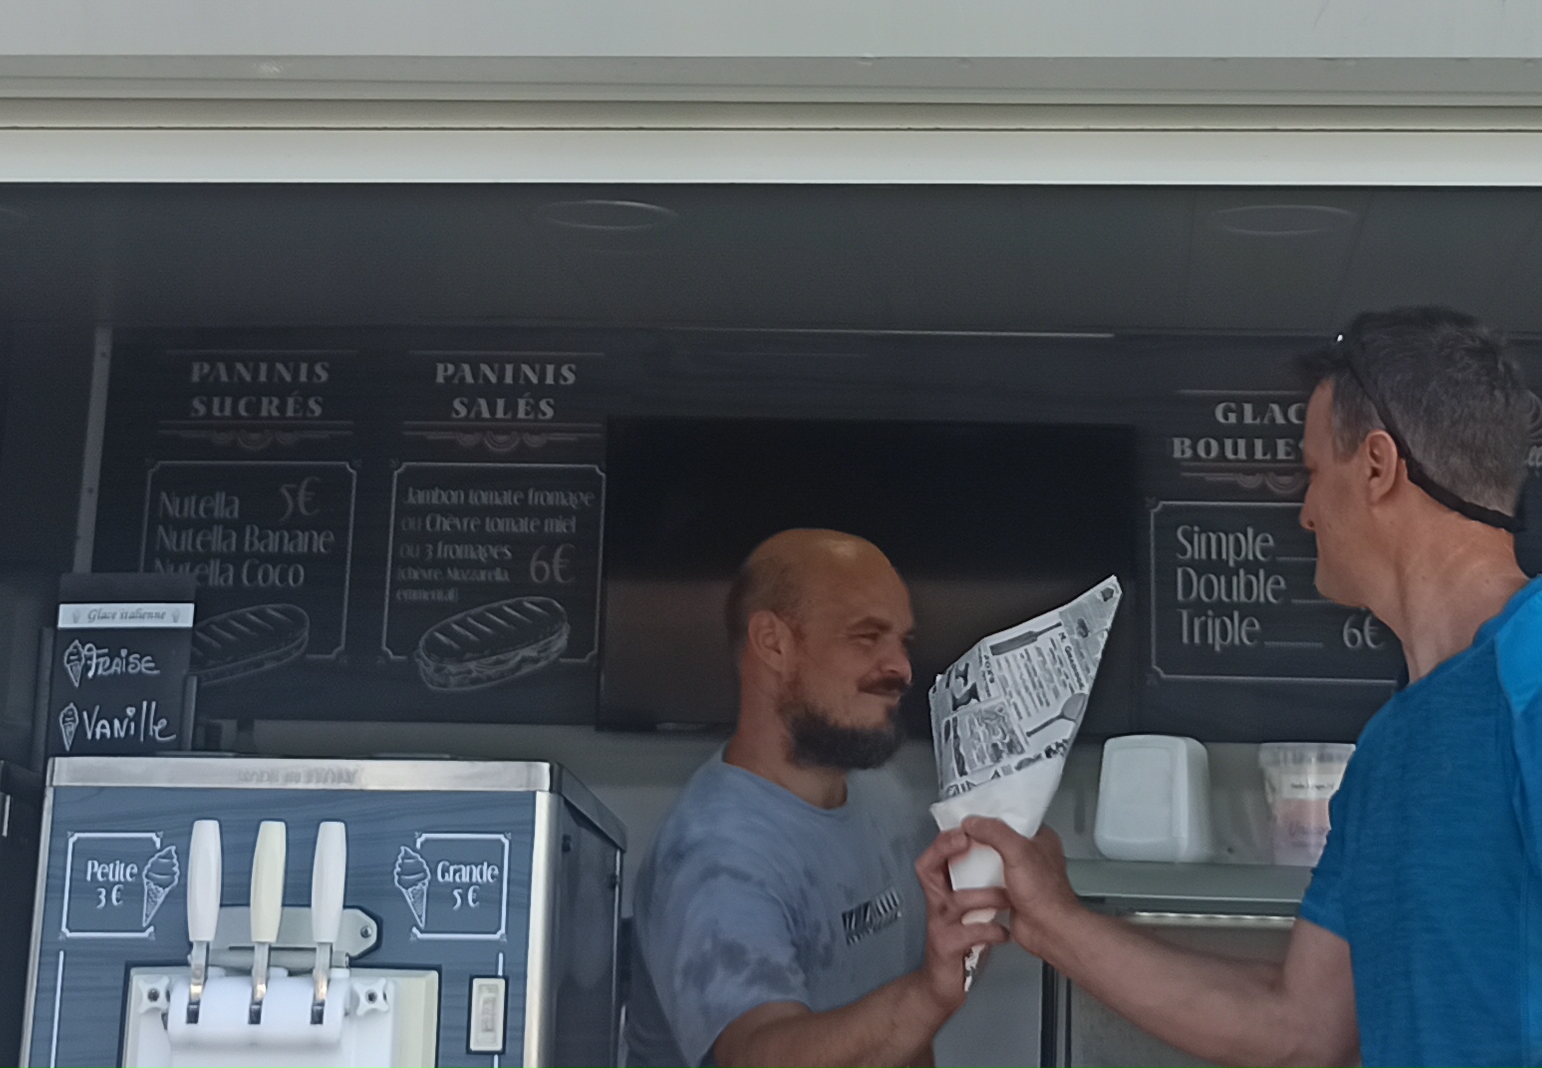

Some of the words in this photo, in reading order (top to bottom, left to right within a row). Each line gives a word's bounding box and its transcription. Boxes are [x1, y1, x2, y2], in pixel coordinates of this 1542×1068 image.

[189, 360, 330, 383] PANINIS
[434, 361, 578, 385] PANINIS
[189, 389, 325, 418] SUCRÉS
[450, 391, 556, 420] SALÉS
[158, 490, 241, 520] Nutella
[278, 475, 322, 522] 5€
[469, 487, 524, 506] tomate
[528, 487, 596, 510] fromage
[425, 512, 481, 533] Chèvre
[485, 515, 541, 534] tomate
[544, 515, 577, 534] miel
[155, 524, 236, 553] Nutella
[244, 524, 336, 554] Banane
[436, 540, 514, 563] fromages
[1175, 525, 1276, 568] Simple
[241, 557, 305, 588] Coco
[528, 542, 577, 585] 6€
[1176, 566, 1287, 605] Double
[1176, 608, 1261, 652] Triple
[85, 859, 138, 883] Petite
[436, 860, 500, 883] Grande
